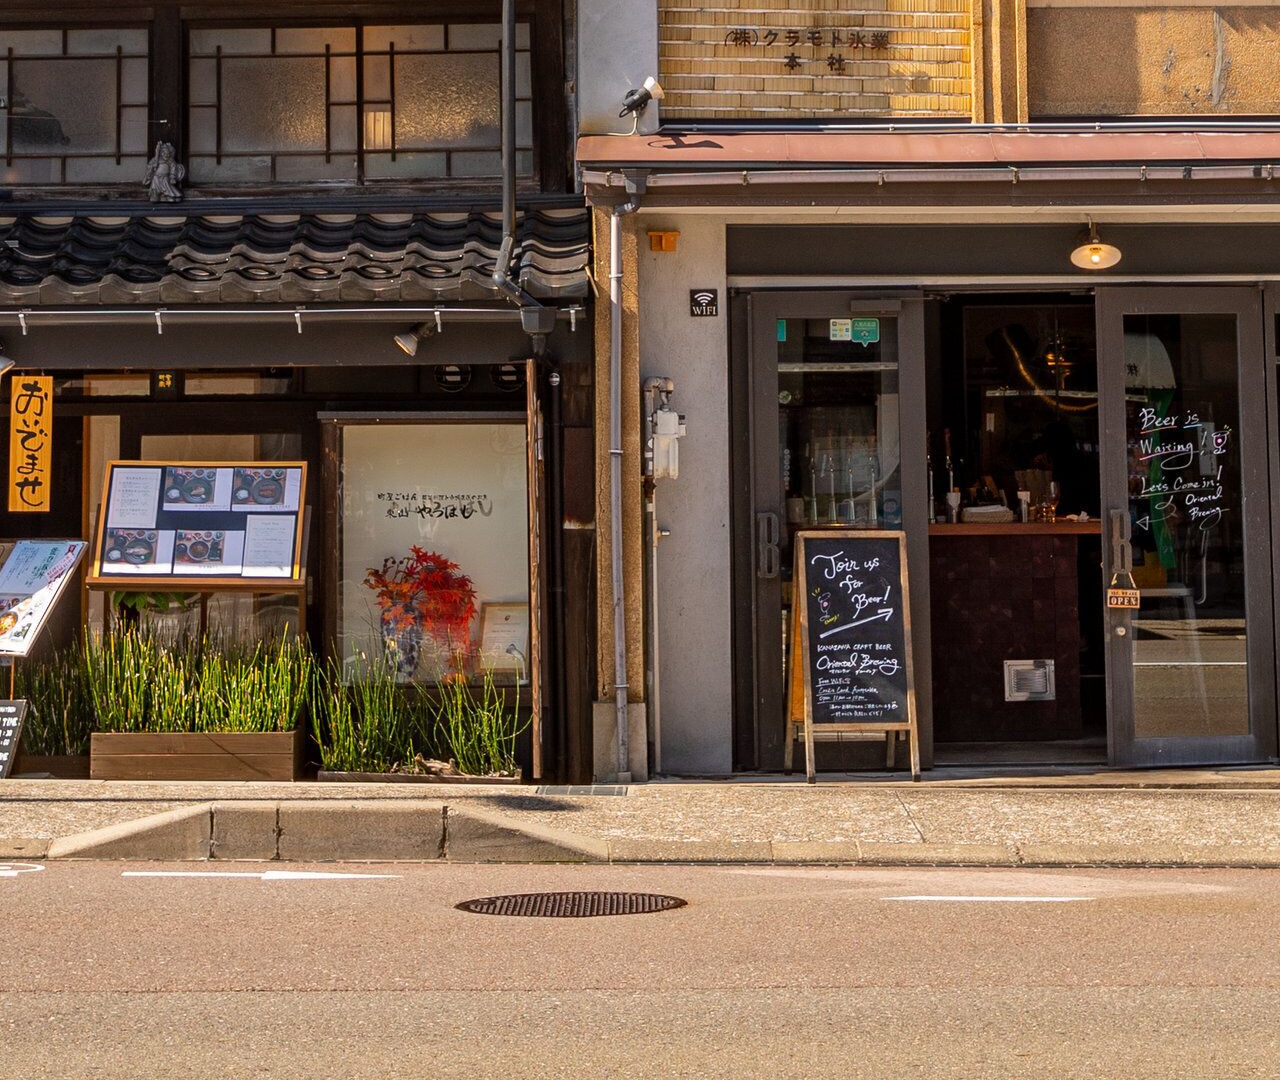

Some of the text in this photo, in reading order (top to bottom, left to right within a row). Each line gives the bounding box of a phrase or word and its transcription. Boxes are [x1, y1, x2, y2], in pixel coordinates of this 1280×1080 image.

[1139, 408, 1200, 430] Beer is
[14, 380, 49, 508] おいでませ
[1141, 476, 1169, 494] Let's
[1173, 477, 1200, 491] Come
[1185, 486, 1223, 505] Oriental
[1188, 506, 1230, 531] Brewing
[811, 551, 880, 579] Join us
[839, 574, 864, 594] for
[1111, 597, 1137, 605] OPEN
[817, 644, 851, 652] KANAZAWA
[875, 643, 892, 651] BEER
[816, 652, 902, 675] Oriental Brewing
[2, 717, 18, 726] TIME
